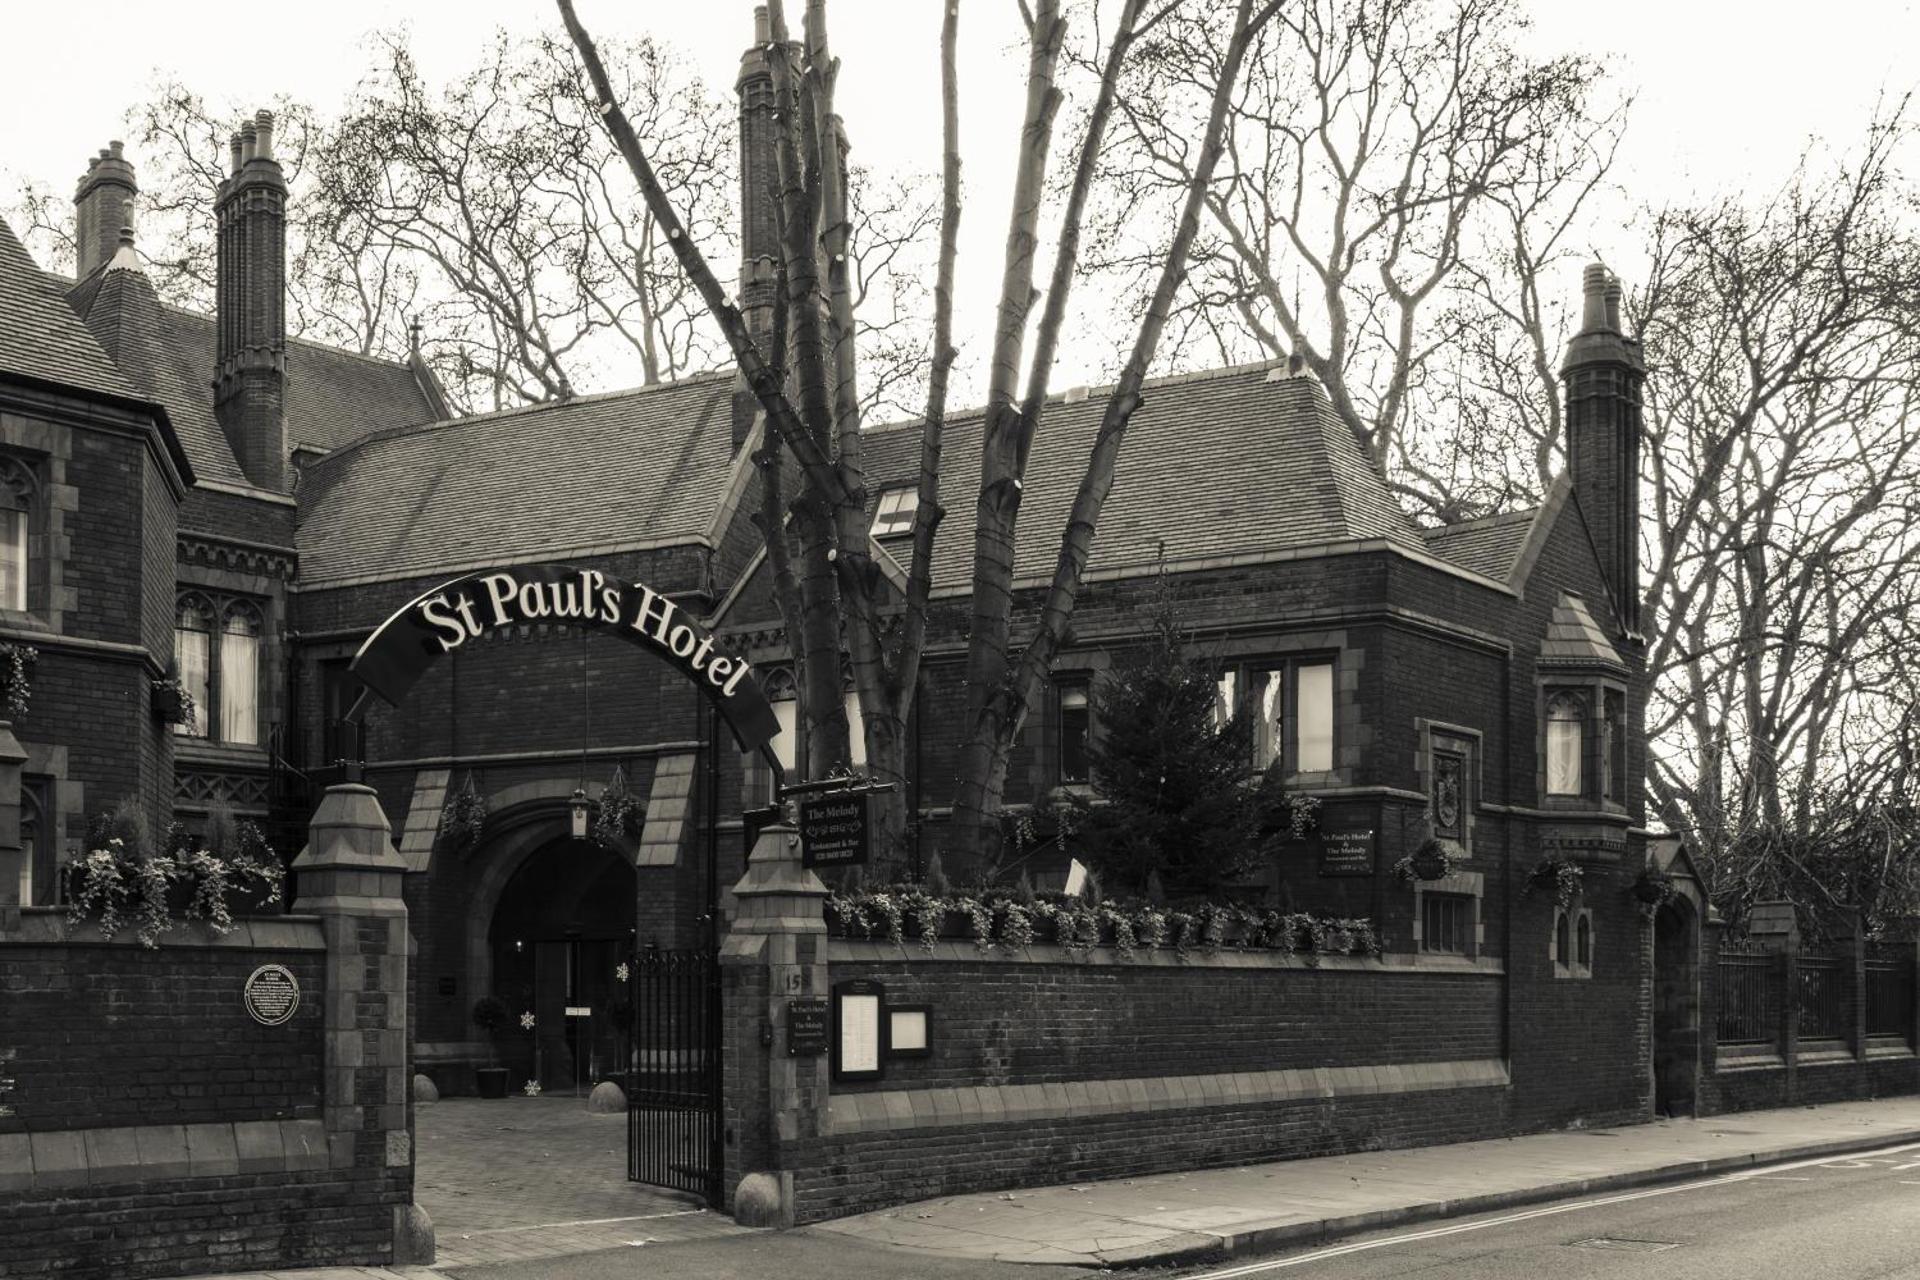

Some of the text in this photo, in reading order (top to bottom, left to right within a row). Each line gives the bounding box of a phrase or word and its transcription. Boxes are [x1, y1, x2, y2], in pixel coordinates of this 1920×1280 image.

[418, 570, 750, 698] St Paul's Hotel
[807, 803, 859, 820] The Melody
[1351, 833, 1371, 841] Hotel
[1340, 846, 1366, 855] Melody
